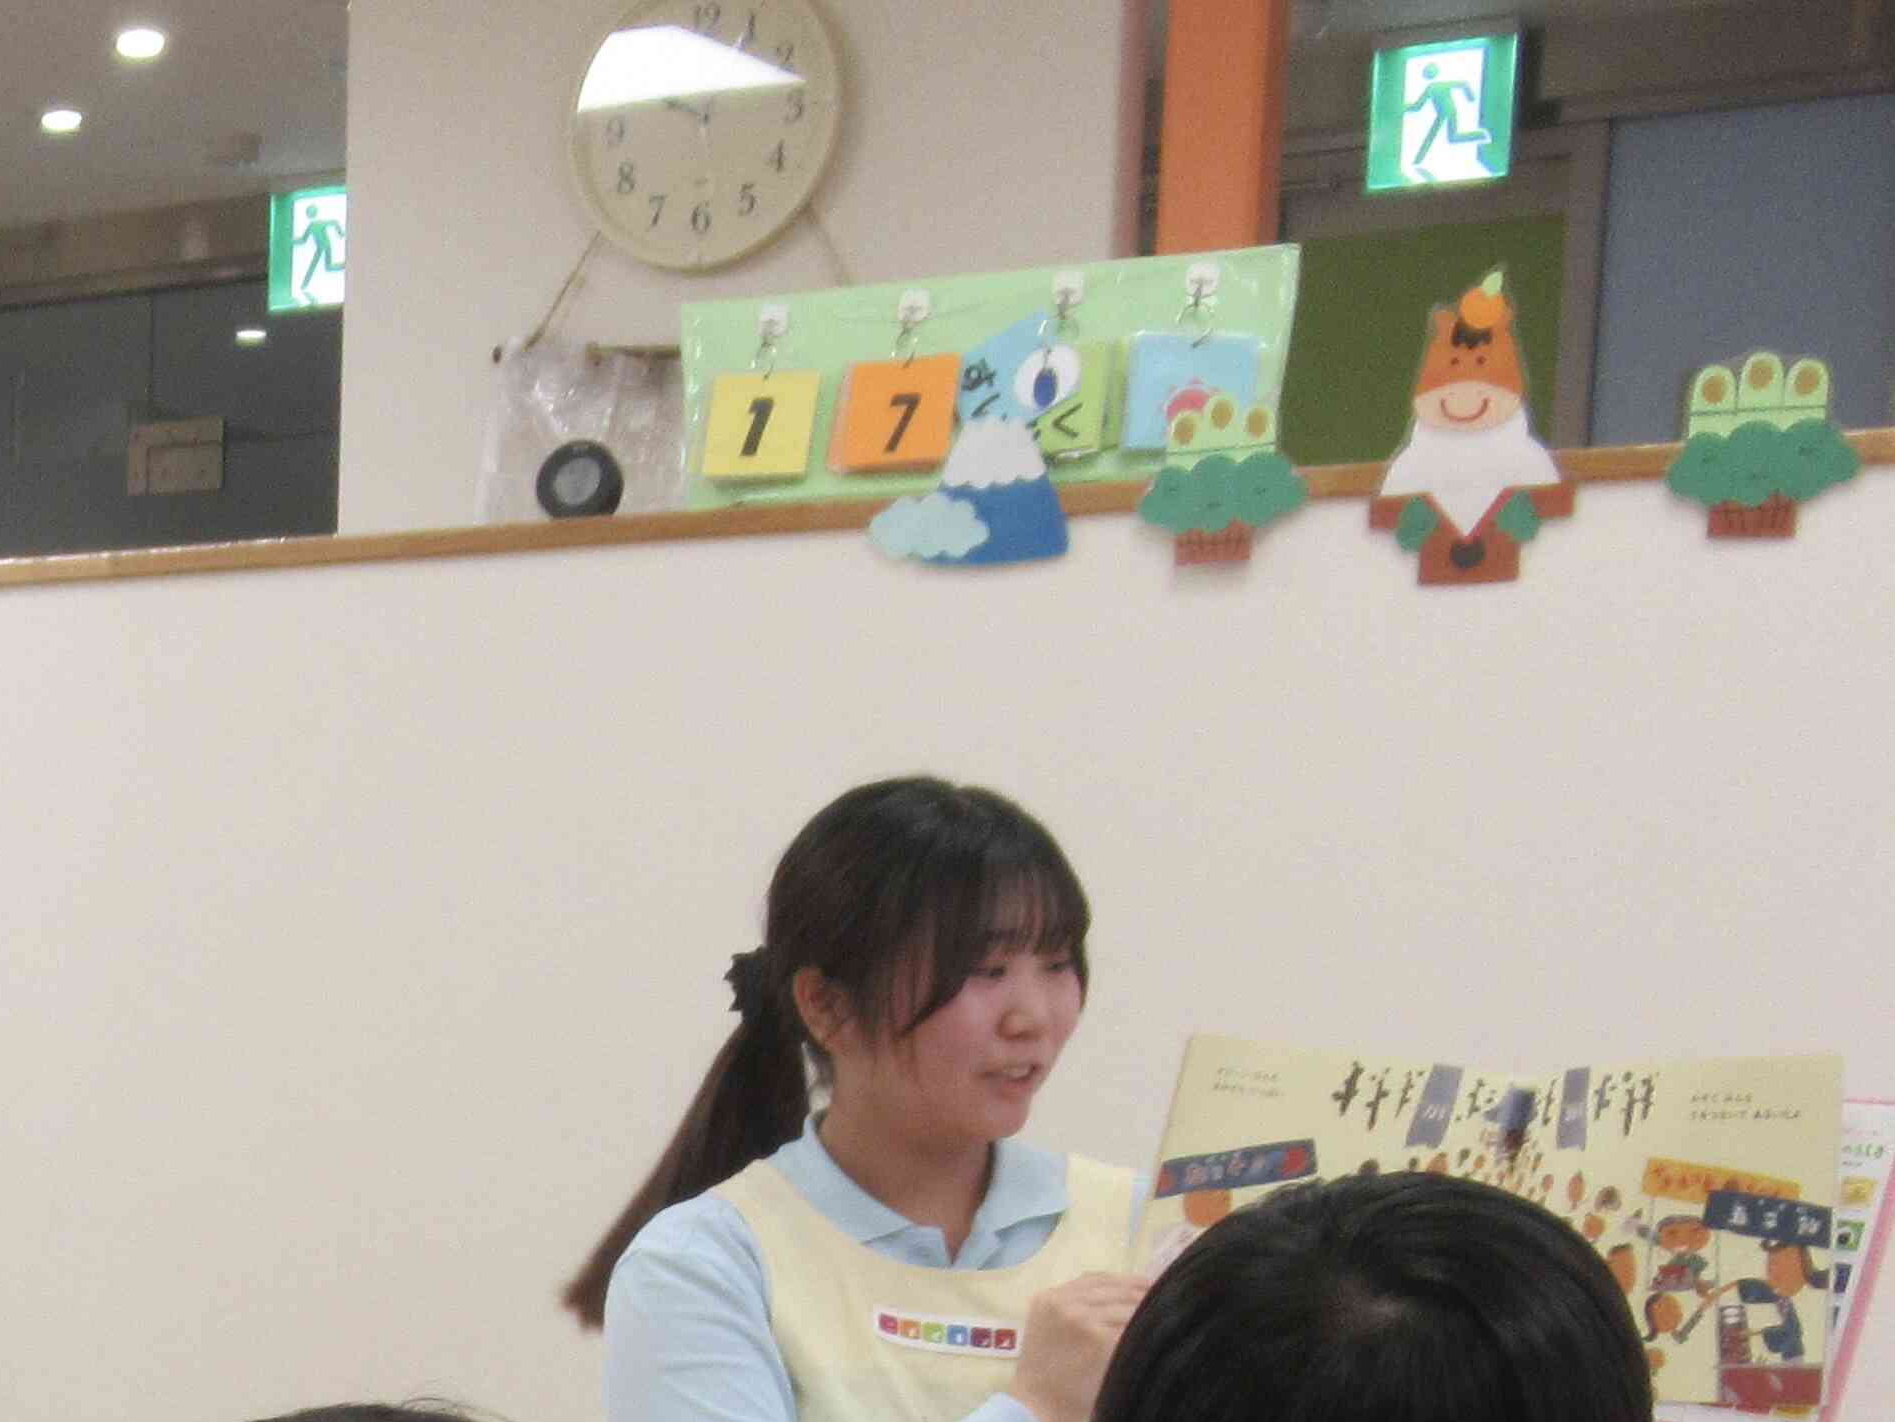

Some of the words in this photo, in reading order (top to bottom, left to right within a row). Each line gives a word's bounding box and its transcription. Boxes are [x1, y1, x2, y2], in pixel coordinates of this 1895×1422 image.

[784, 90, 803, 123] 3
[606, 117, 625, 147] 9
[766, 140, 786, 173] 4
[617, 161, 636, 194] 8
[648, 194, 668, 229] 7
[738, 183, 757, 217] 5
[691, 201, 712, 234] 6
[739, 397, 775, 457] 1
[884, 393, 922, 454] 7
